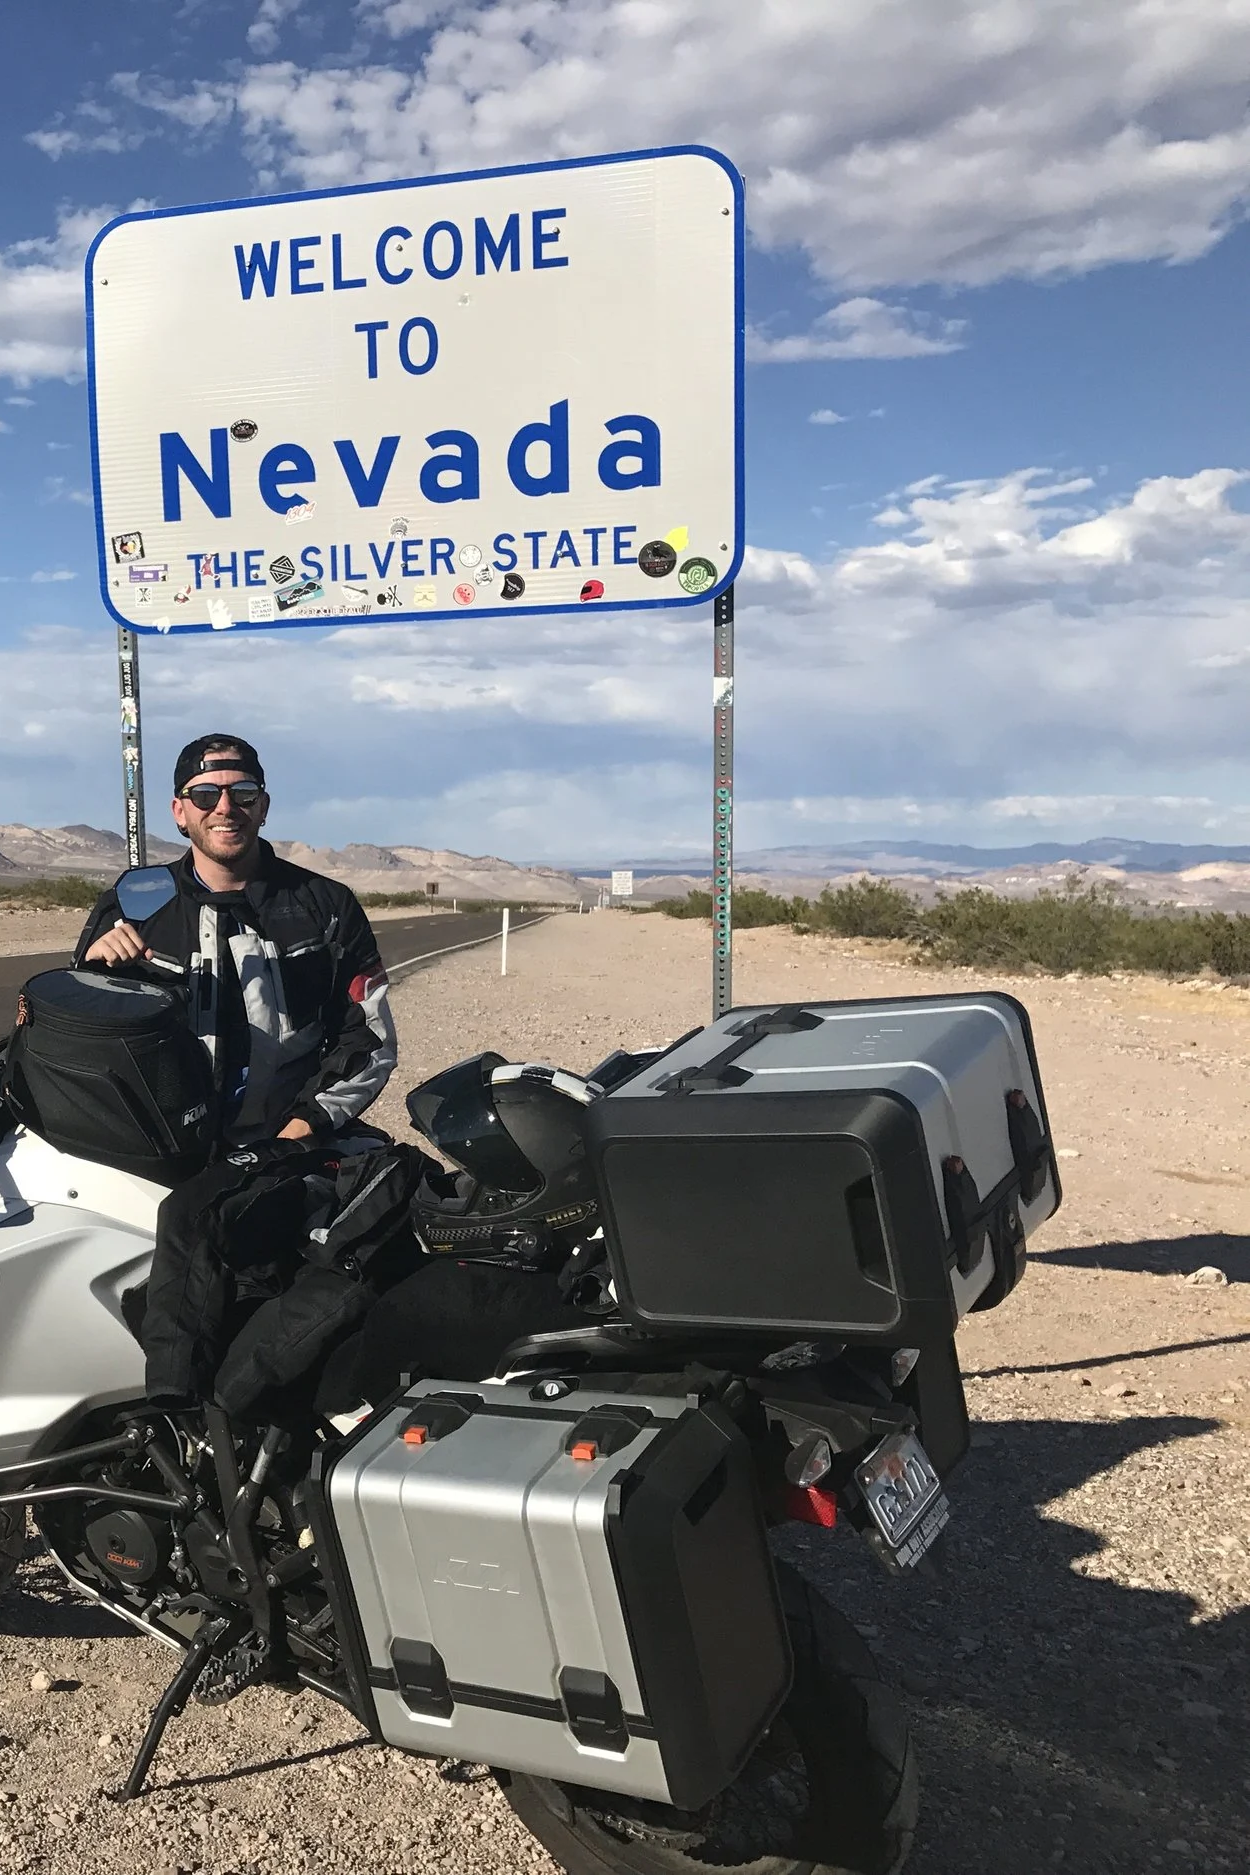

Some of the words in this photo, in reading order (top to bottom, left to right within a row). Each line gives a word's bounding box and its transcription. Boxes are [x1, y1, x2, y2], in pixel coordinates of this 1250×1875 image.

[235, 208, 568, 300] WELCOME
[355, 317, 438, 379] TO
[160, 399, 661, 522] Nevada
[186, 549, 267, 590] THE
[299, 537, 456, 582] SILVER
[492, 525, 639, 572] STATE
[183, 1103, 208, 1127] KTM
